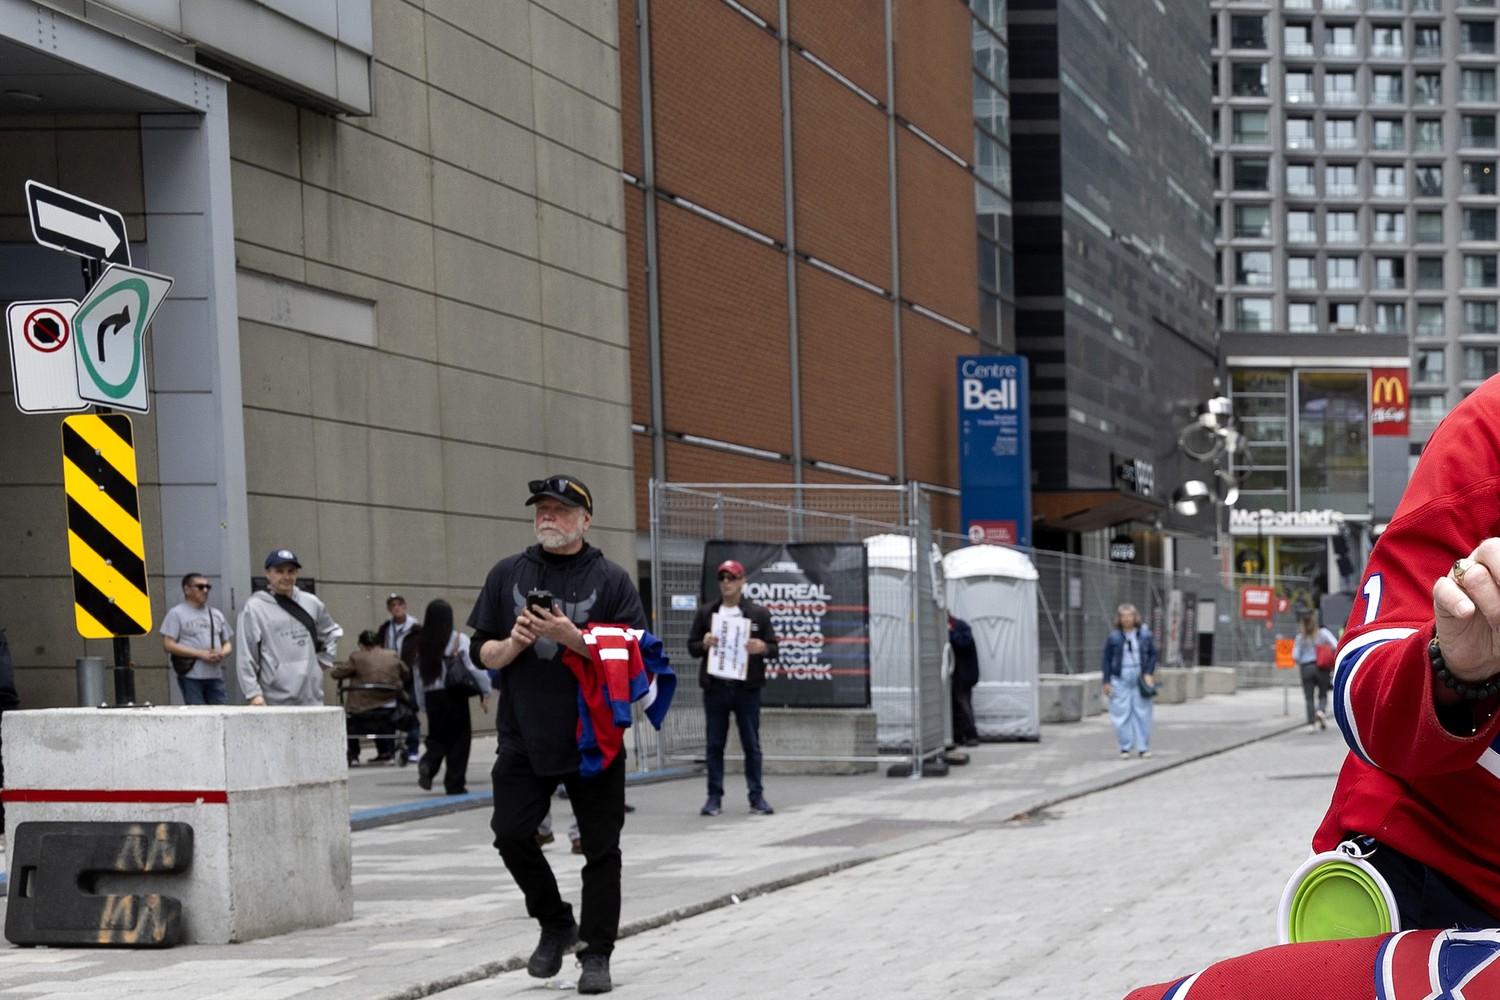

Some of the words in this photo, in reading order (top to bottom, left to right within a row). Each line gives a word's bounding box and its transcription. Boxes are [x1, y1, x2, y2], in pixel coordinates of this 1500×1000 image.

[962, 360, 1017, 378] Centre
[963, 379, 1017, 410] Bell
[1231, 508, 1344, 527] McDonald's
